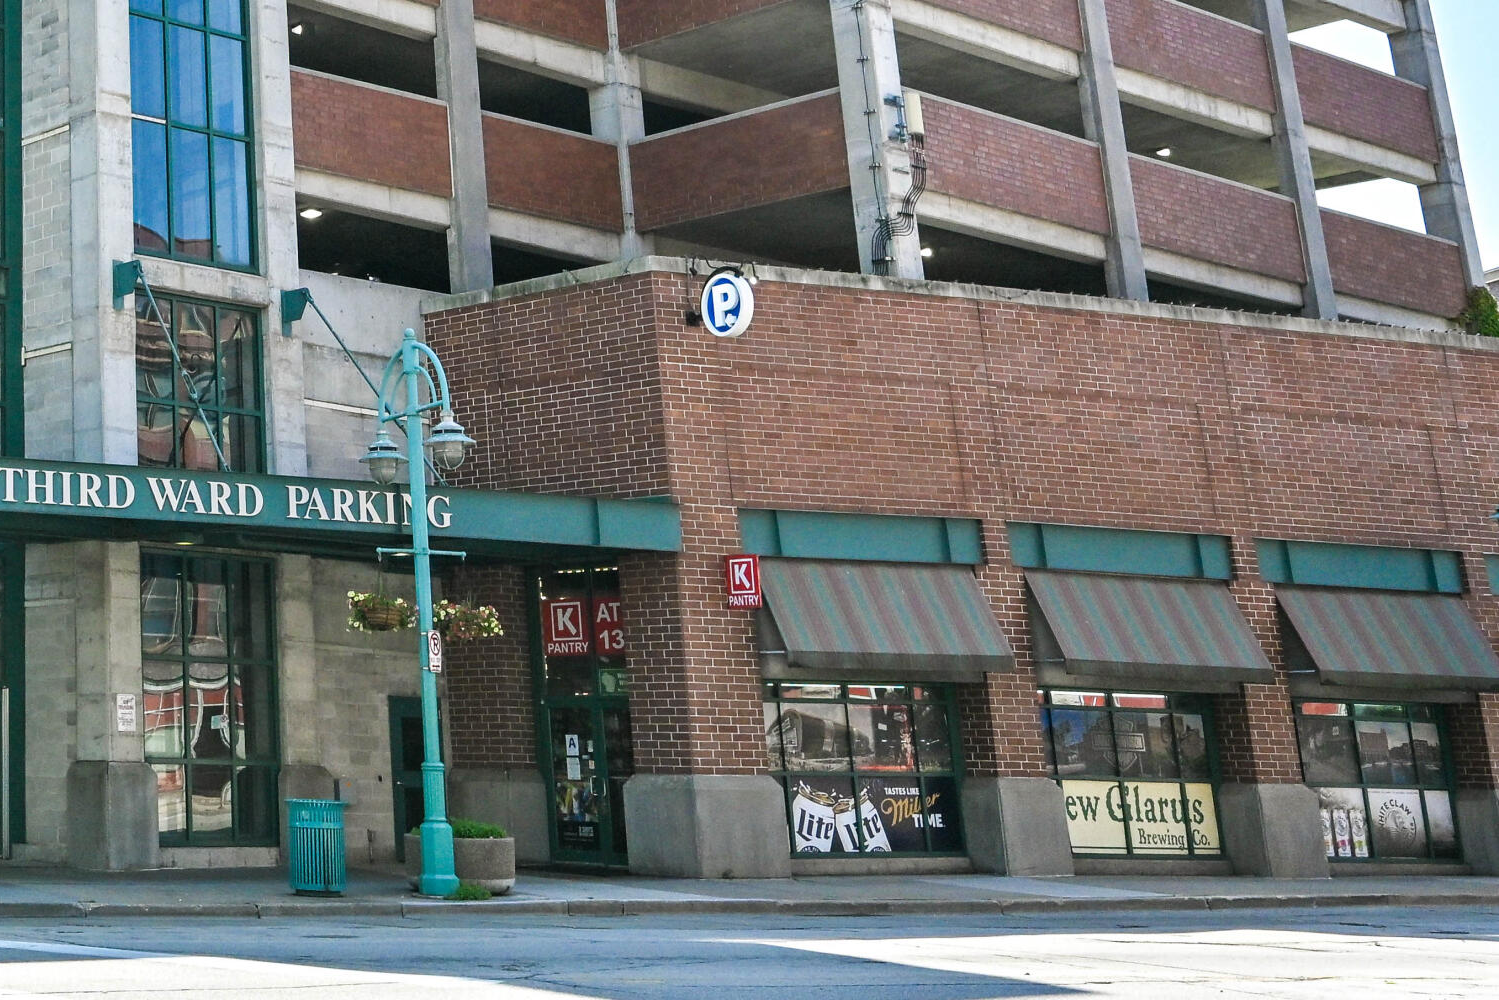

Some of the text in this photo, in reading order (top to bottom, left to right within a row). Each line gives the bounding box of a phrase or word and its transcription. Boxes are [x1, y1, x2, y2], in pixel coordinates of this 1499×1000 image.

[712, 283, 740, 328] P
[145, 476, 265, 517] WARD
[734, 563, 751, 589] K
[728, 594, 759, 606] PANTRY
[556, 607, 578, 636] K
[547, 642, 589, 653] PANTRY
[568, 737, 577, 749] A
[884, 787, 920, 796] TASTES LIKE
[1106, 784, 1205, 825] Glarus
[880, 792, 941, 826] Miler
[1389, 799, 1412, 816] CLAW
[796, 807, 834, 842] Lite
[843, 813, 881, 851] Lte
[1137, 828, 1211, 851] Brewing Co.
